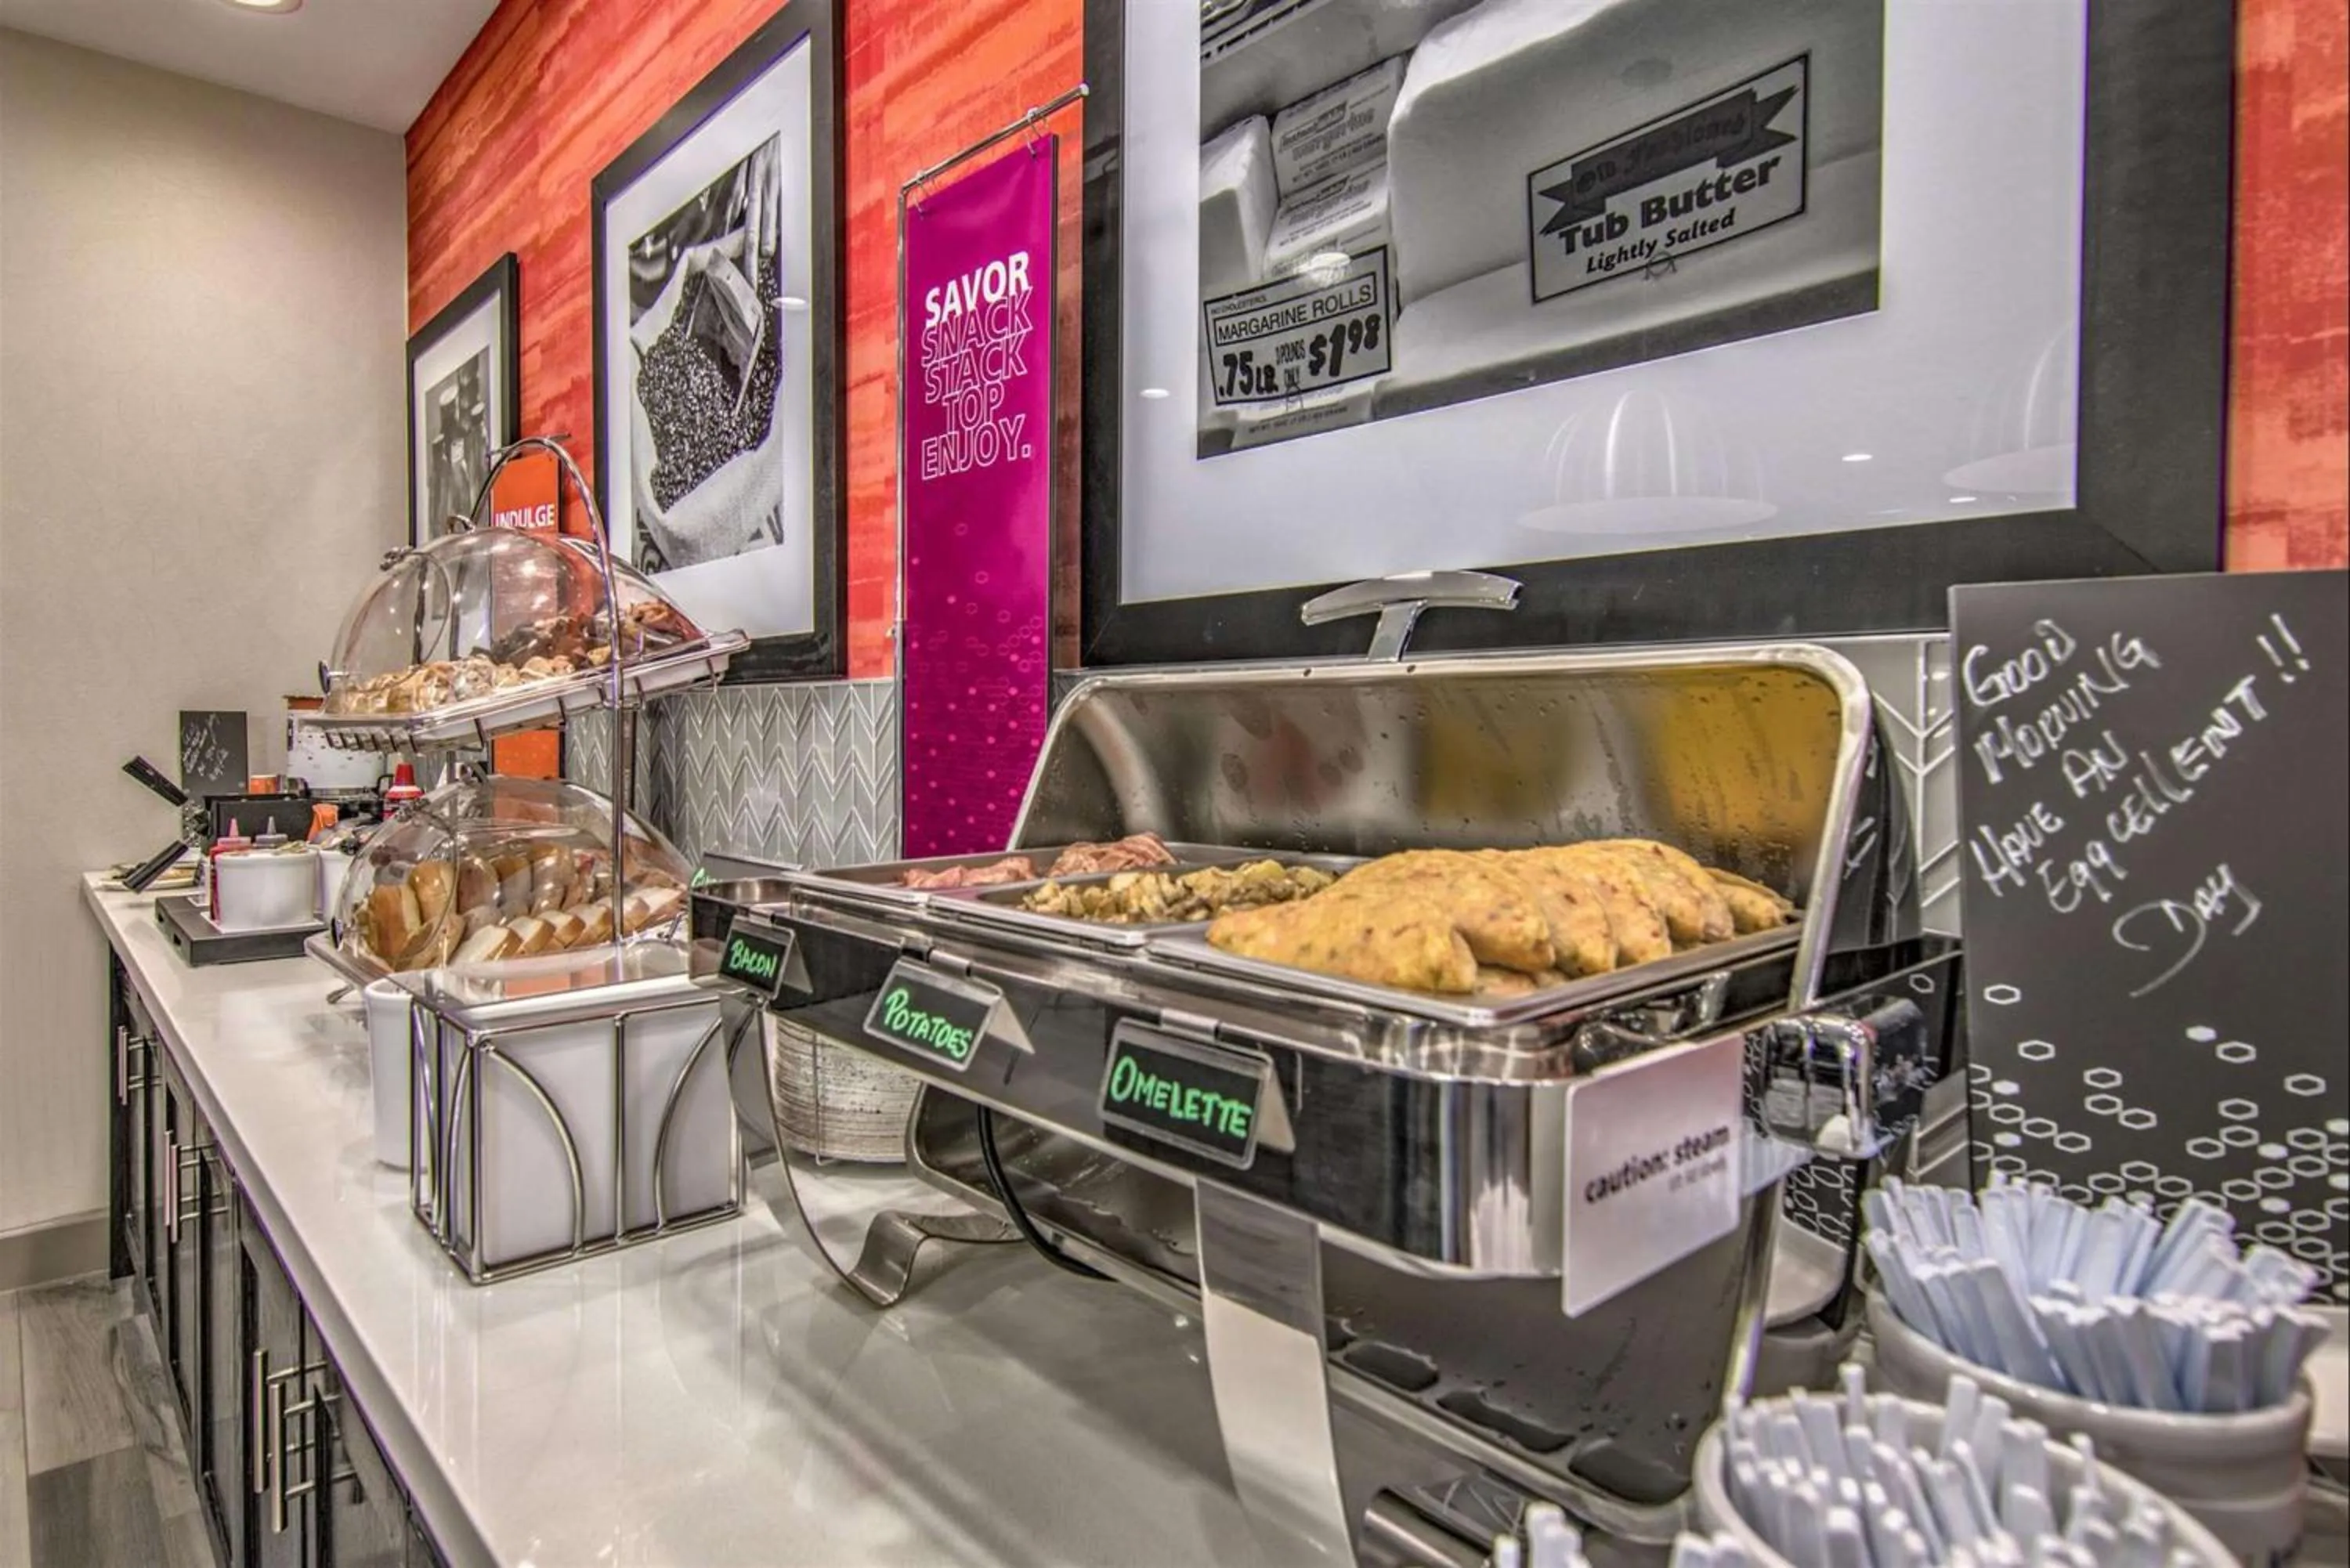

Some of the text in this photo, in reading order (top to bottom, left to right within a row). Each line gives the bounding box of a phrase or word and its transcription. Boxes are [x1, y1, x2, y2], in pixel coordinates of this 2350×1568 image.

[1557, 156, 1782, 255] Tub Butter
[1585, 207, 1737, 273] Lightly Salted
[925, 251, 1030, 330] SAVOR
[1217, 284, 1372, 342] MARGARINE ROLLS
[921, 286, 1033, 367] SNACK
[925, 331, 1028, 404] STACK
[942, 381, 1004, 435] TOP
[921, 413, 1032, 480] ENJOY.
[494, 504, 555, 528] INDULGE
[1973, 632, 2161, 784] MORNING
[2061, 730, 2129, 798] AN
[728, 938, 778, 978] BACON
[884, 988, 972, 1058] POTATOES
[1111, 1055, 1253, 1140] OMELETTE
[1584, 1148, 1669, 1205] caution:
[1673, 1125, 1730, 1166] steam
